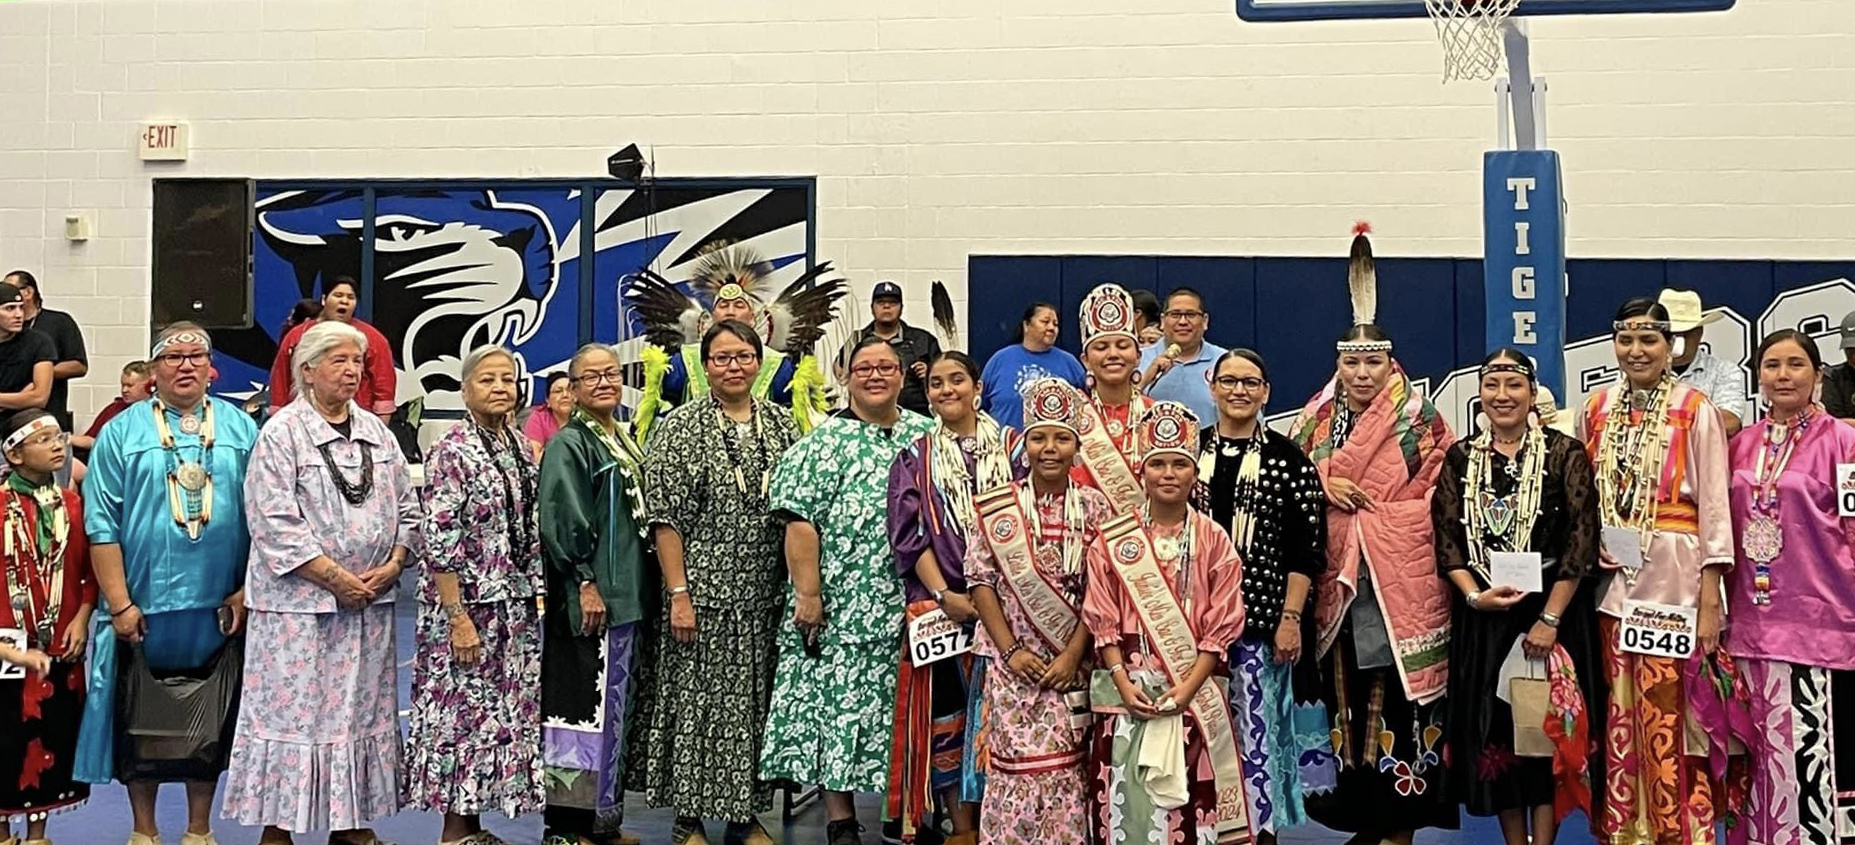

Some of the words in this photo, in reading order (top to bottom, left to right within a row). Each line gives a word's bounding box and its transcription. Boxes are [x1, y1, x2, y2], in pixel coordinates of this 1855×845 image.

[148, 125, 177, 148] EXIT
[1506, 177, 1538, 346] TIGE
[1624, 627, 1690, 655] 0548
